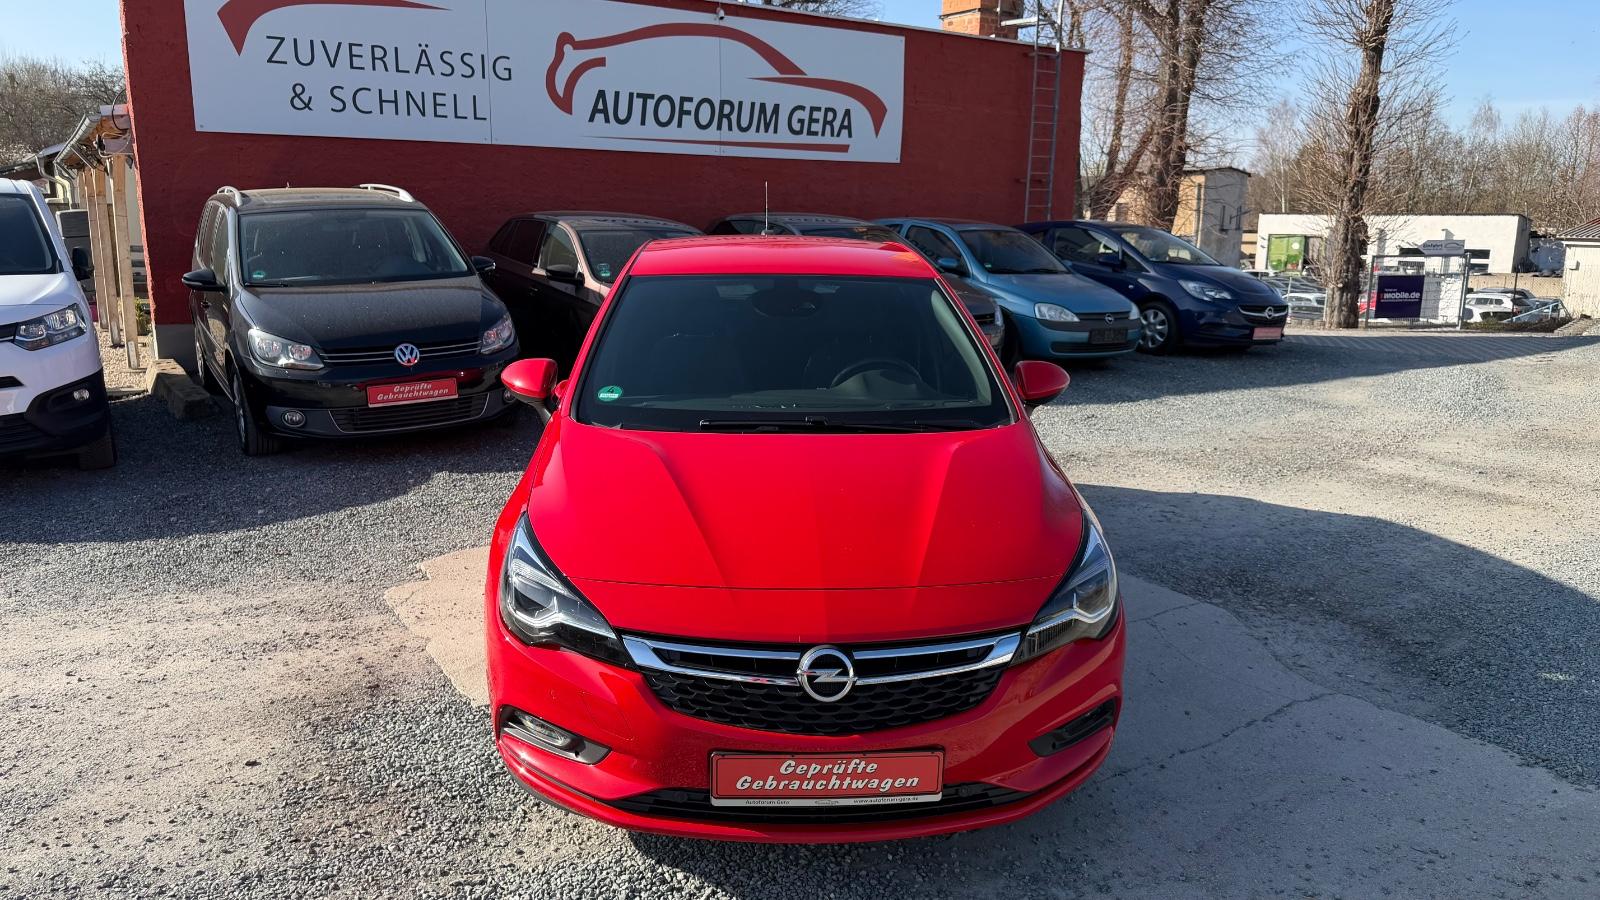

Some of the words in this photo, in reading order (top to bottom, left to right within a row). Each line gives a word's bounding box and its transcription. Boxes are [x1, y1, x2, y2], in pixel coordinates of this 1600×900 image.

[266, 35, 512, 81] ZUVERLÄSSIG
[289, 82, 314, 111] &
[329, 85, 487, 121] SCHNELL
[588, 89, 780, 134] AUTOFORUM
[787, 104, 853, 138] GERA
[377, 388, 449, 401] Gebrauchtwagen
[393, 383, 432, 393] Geprüfte
[779, 759, 878, 778] Geprüfte
[735, 776, 919, 792] Gebrauchtwagen
